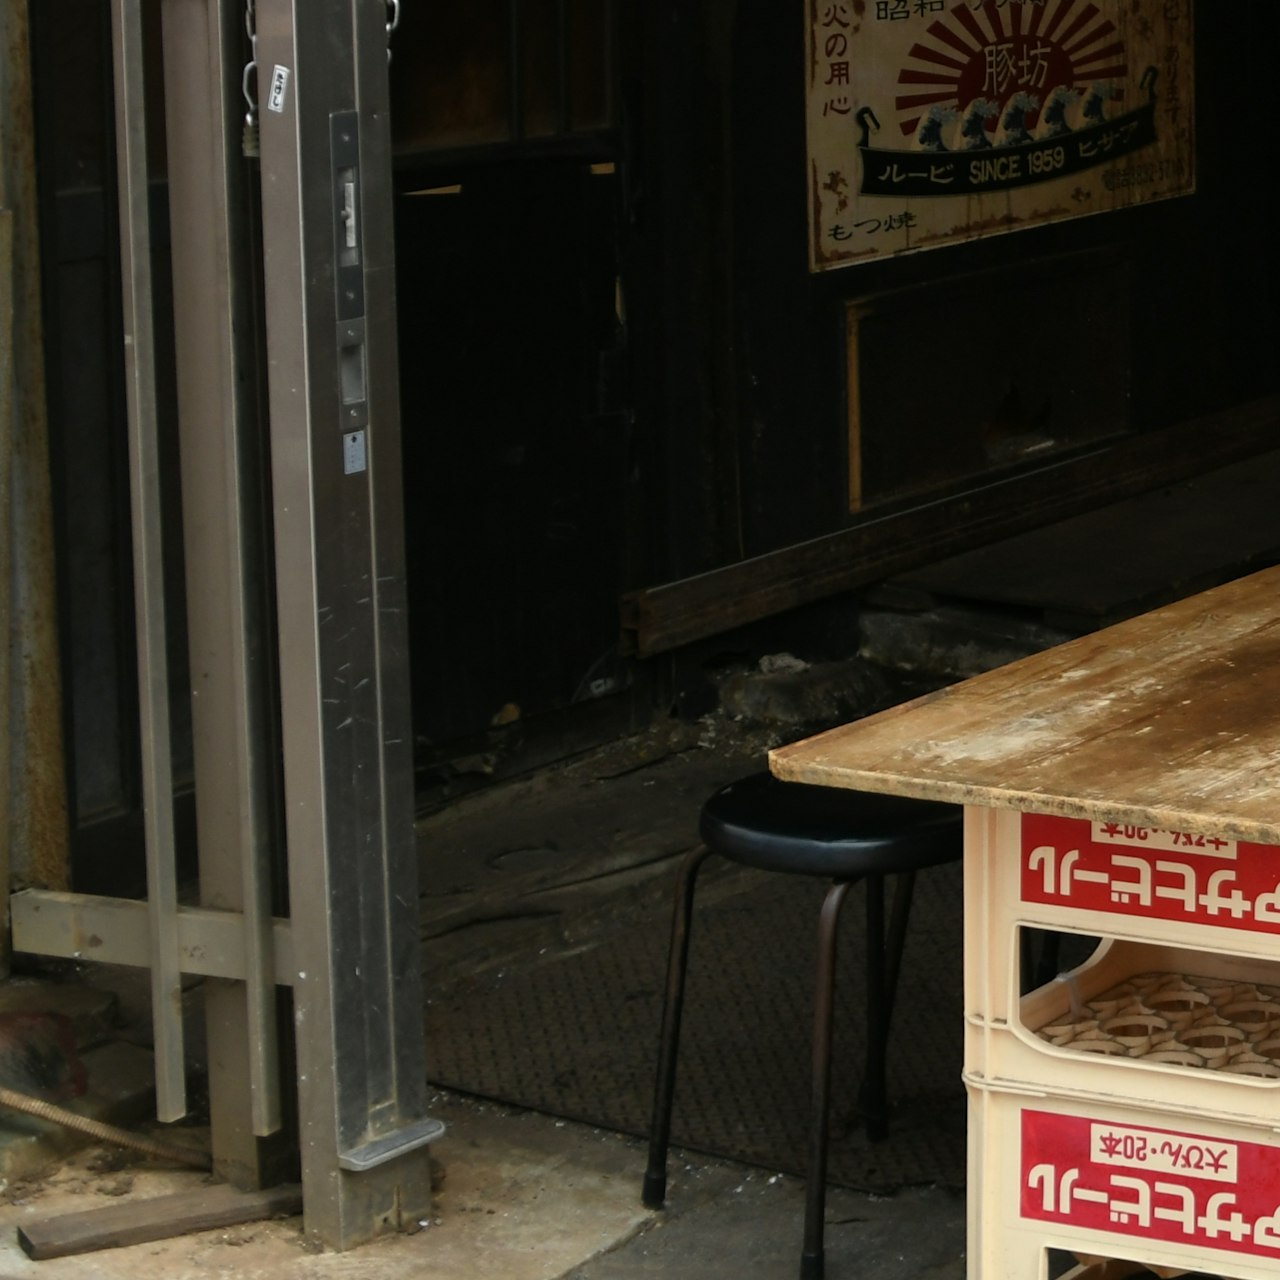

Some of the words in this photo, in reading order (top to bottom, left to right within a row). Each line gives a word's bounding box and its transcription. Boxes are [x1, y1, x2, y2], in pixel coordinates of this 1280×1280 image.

[822, 3, 852, 118] 火の用心
[981, 41, 1052, 96] 豚坊
[877, 163, 955, 184] ルービ
[969, 155, 1022, 185] SINCE
[1027, 148, 1065, 176] 1959
[1078, 122, 1138, 158] ヒサア
[827, 212, 918, 242] もつ焼
[1099, 1132, 1229, 1174] 大びん・20本
